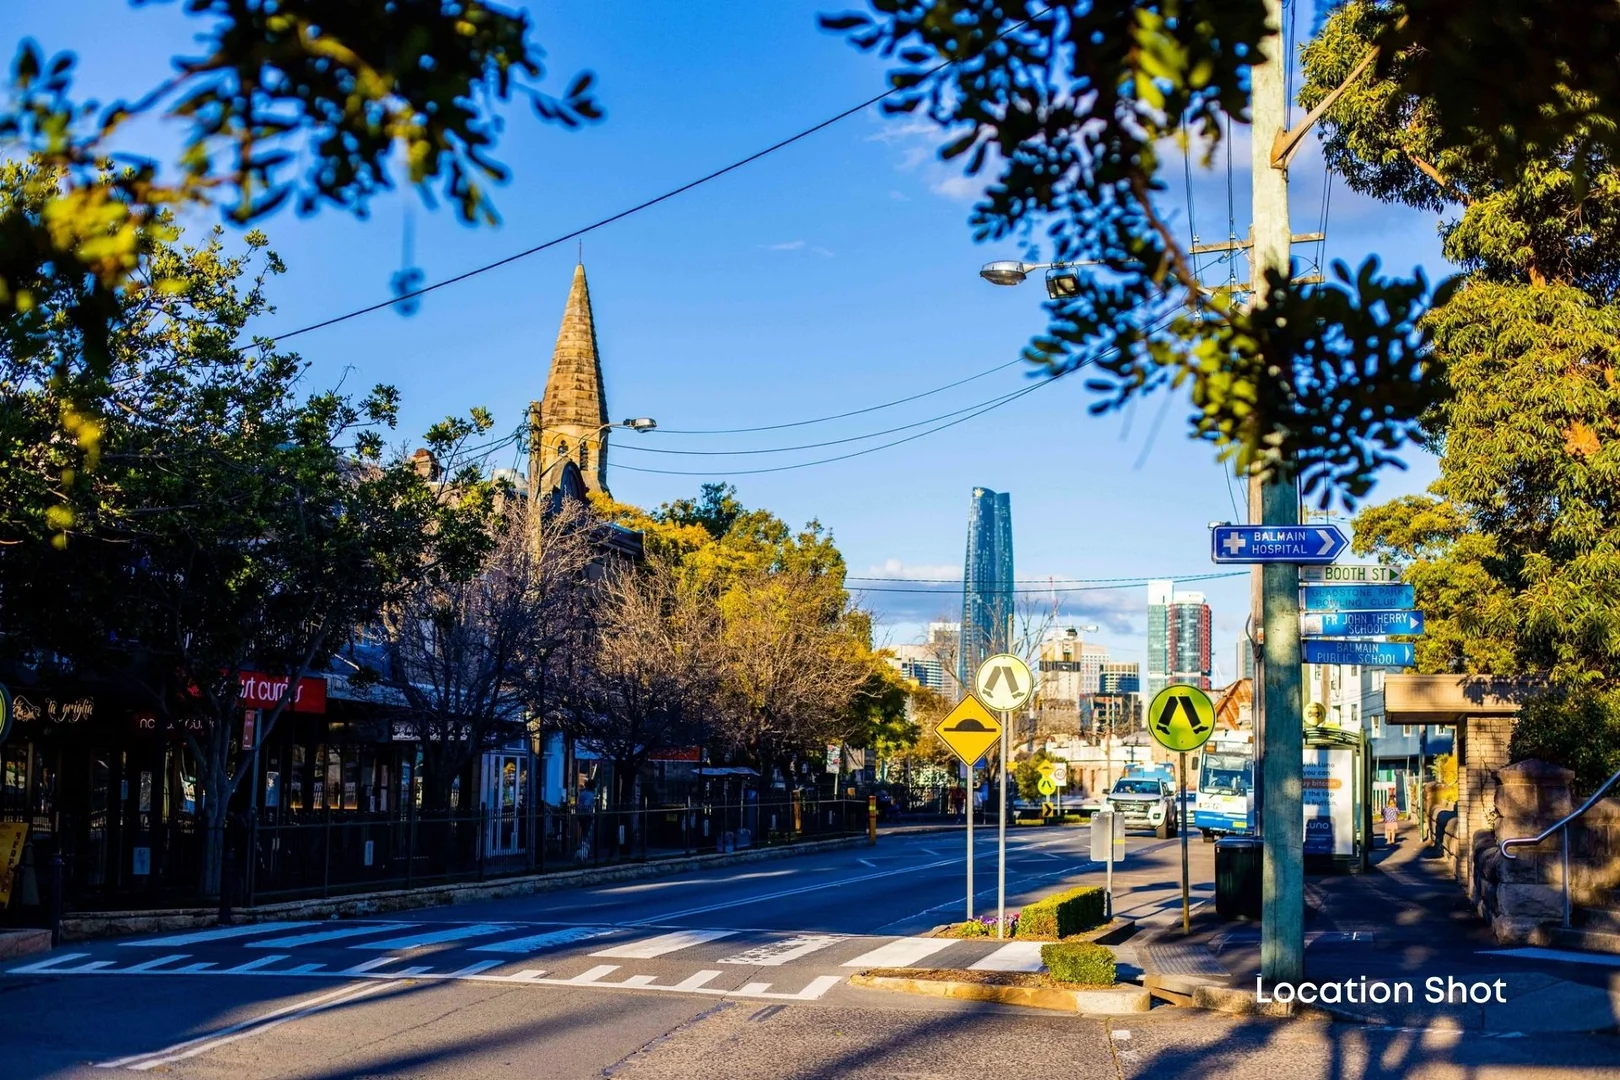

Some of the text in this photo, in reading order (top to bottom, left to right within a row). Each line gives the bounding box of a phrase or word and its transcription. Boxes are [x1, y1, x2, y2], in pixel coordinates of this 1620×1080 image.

[1254, 532, 1306, 542] BALMAIN
[1252, 544, 1308, 554] HOSPITAL
[1325, 567, 1366, 581] BOOTH
[1372, 568, 1386, 581] ST
[1312, 587, 1404, 597] GLADSTONE PARK
[1316, 598, 1396, 607] BOWLING CLUB
[1326, 614, 1408, 625] FR JOHN THERRY
[1348, 624, 1386, 634] SCHOOL
[1336, 642, 1379, 652] BALMAIN
[1318, 652, 1398, 664] PUBLIC SCHOOL
